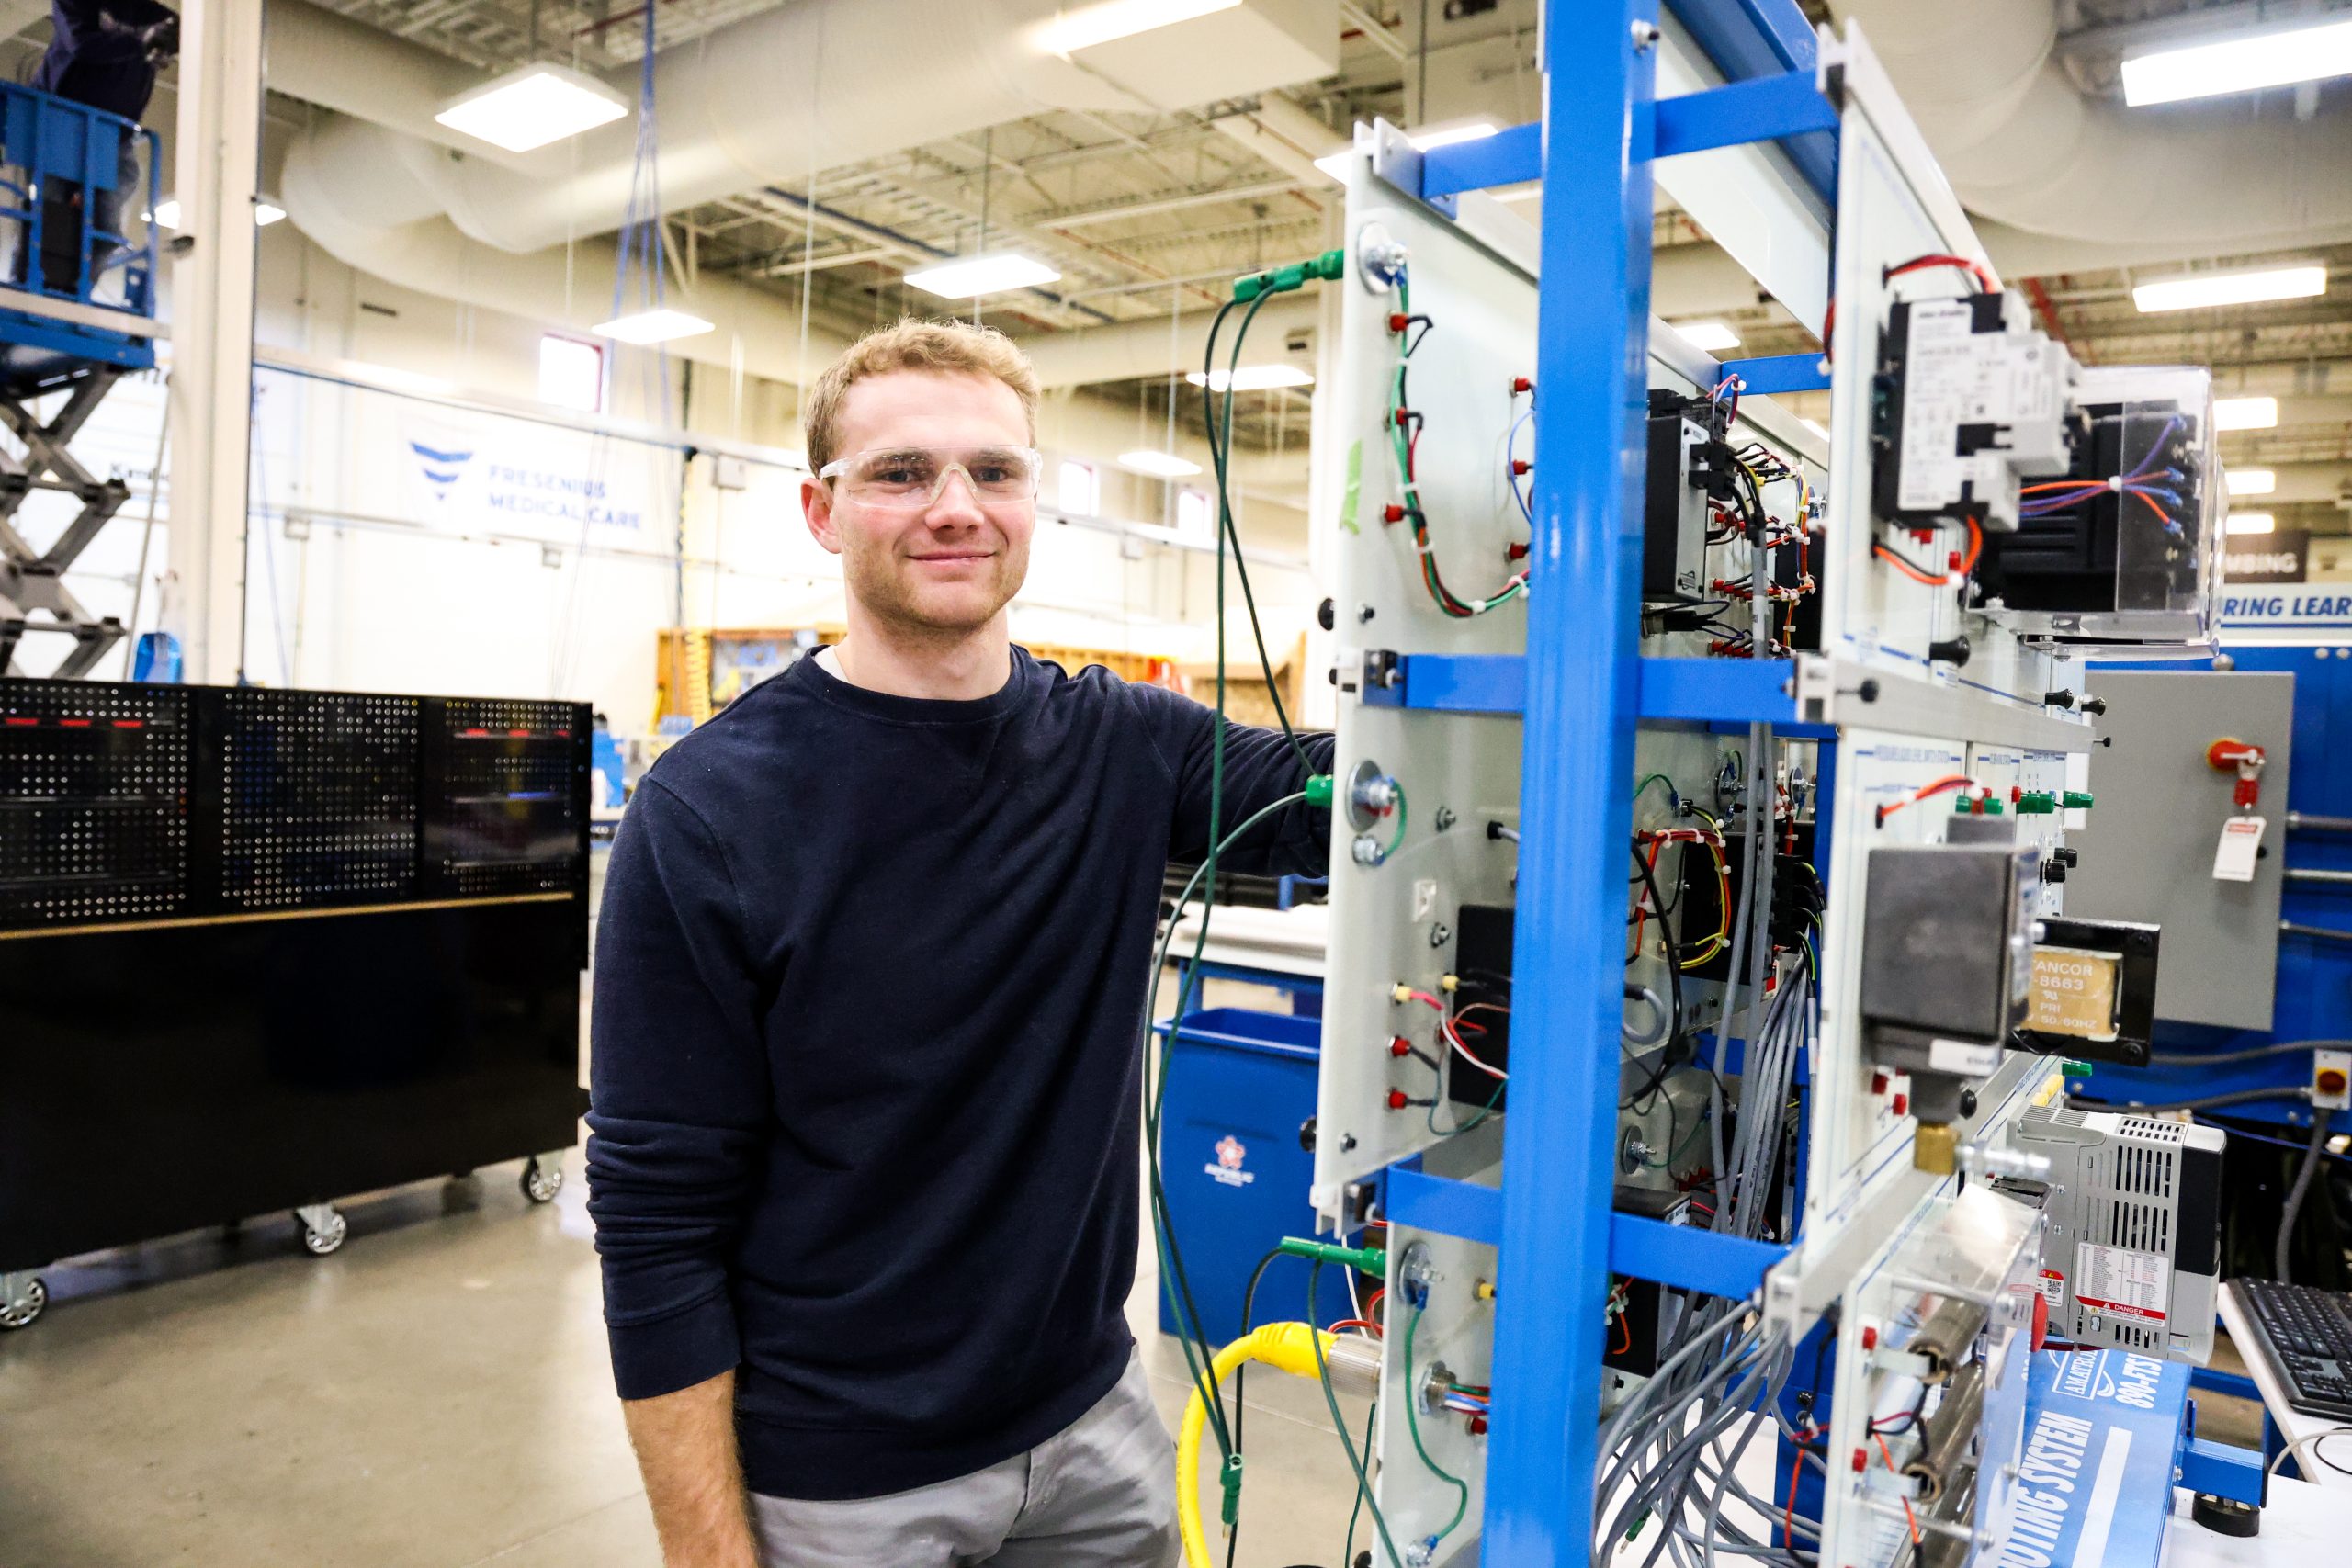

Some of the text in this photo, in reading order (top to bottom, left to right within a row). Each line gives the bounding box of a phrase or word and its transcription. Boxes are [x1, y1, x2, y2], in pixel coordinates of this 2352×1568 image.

[490, 464, 606, 499] FRESENIUS
[490, 492, 641, 530] MEDICAL CARE
[2223, 597, 2284, 617] RING
[2034, 960, 2093, 976] ANCOR
[2114, 1304, 2144, 1315] DANGER
[2018, 1410, 2093, 1494] SYSTEM
